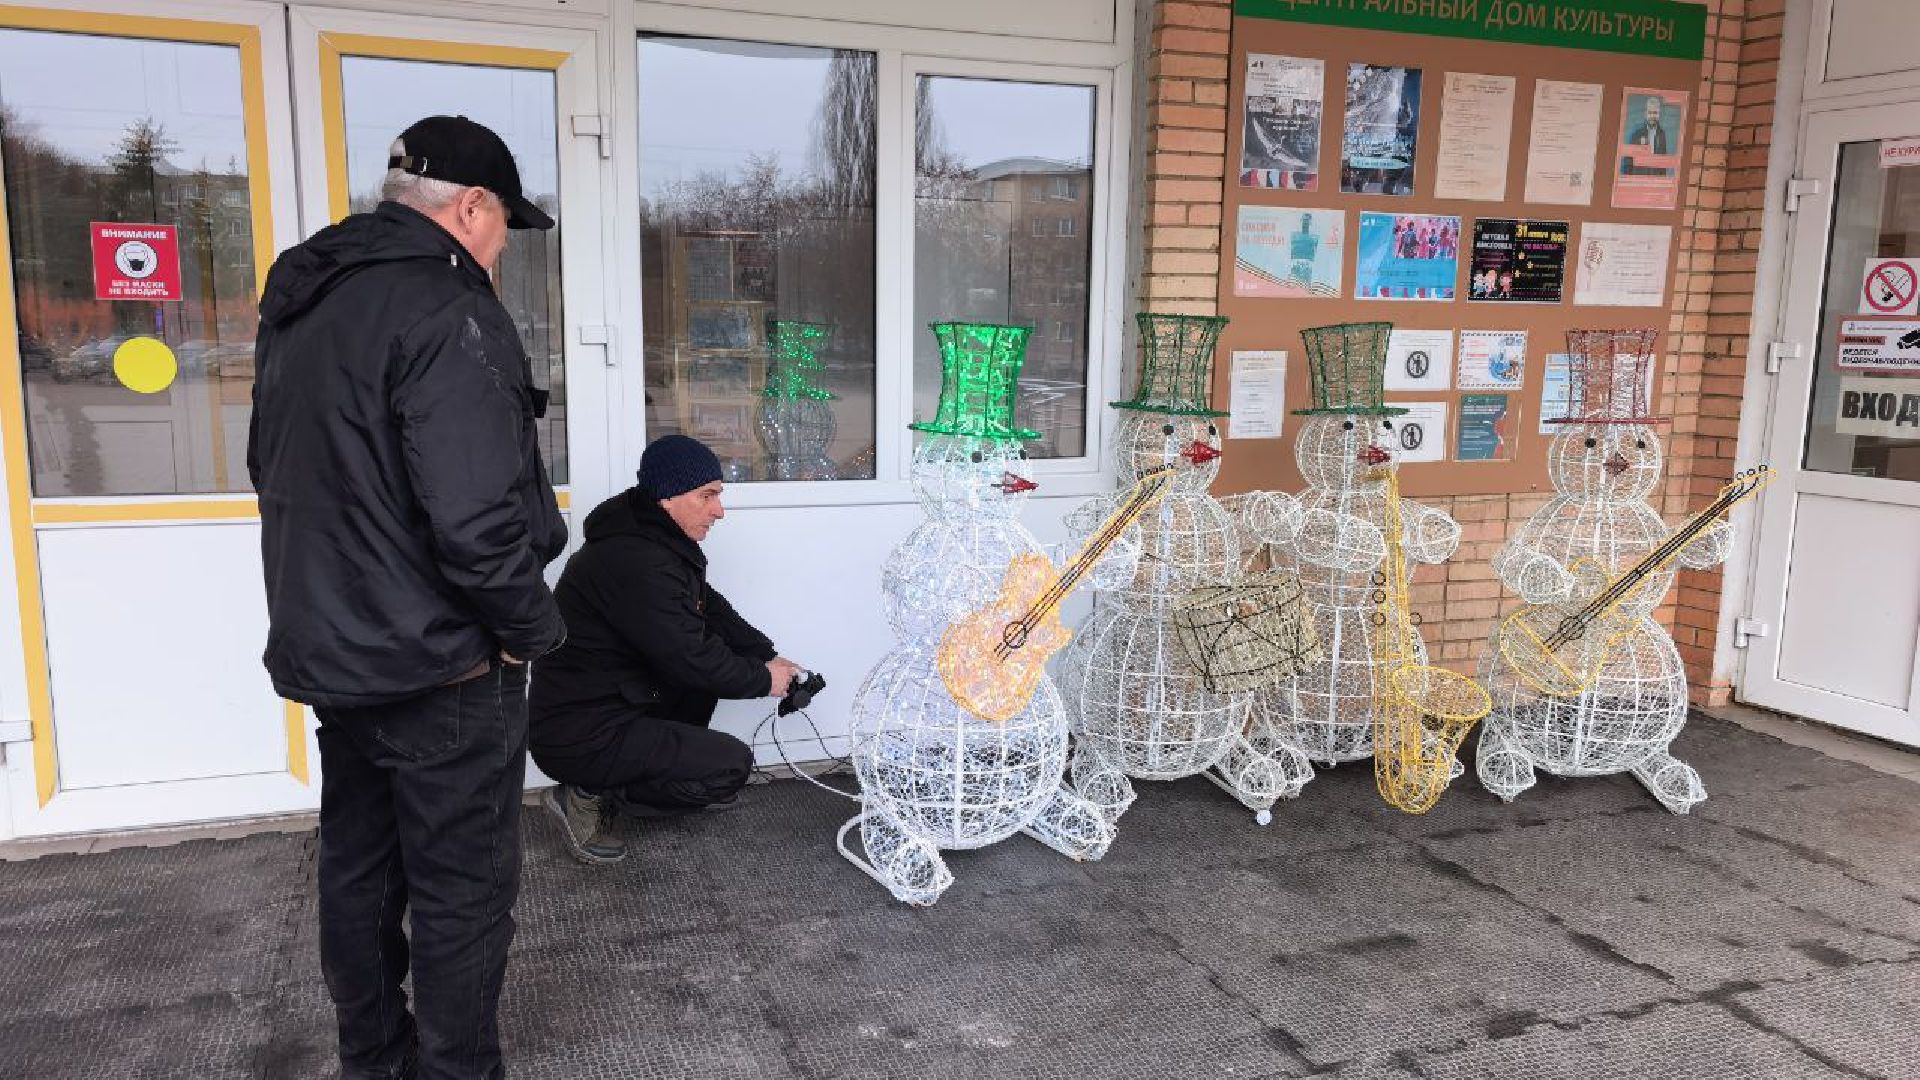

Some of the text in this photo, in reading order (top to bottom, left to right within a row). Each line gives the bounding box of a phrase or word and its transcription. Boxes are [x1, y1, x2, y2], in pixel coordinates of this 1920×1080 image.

[1485, 0, 1546, 30] ДОМ
[1553, 6, 1676, 42] КУЛЬТУРЫ
[101, 228, 167, 239] ВНИМАНИЕ
[132, 280, 165, 288] МАСКИ
[124, 288, 168, 296] ВХОДИТЬ
[1841, 391, 1920, 427] ВХОД
